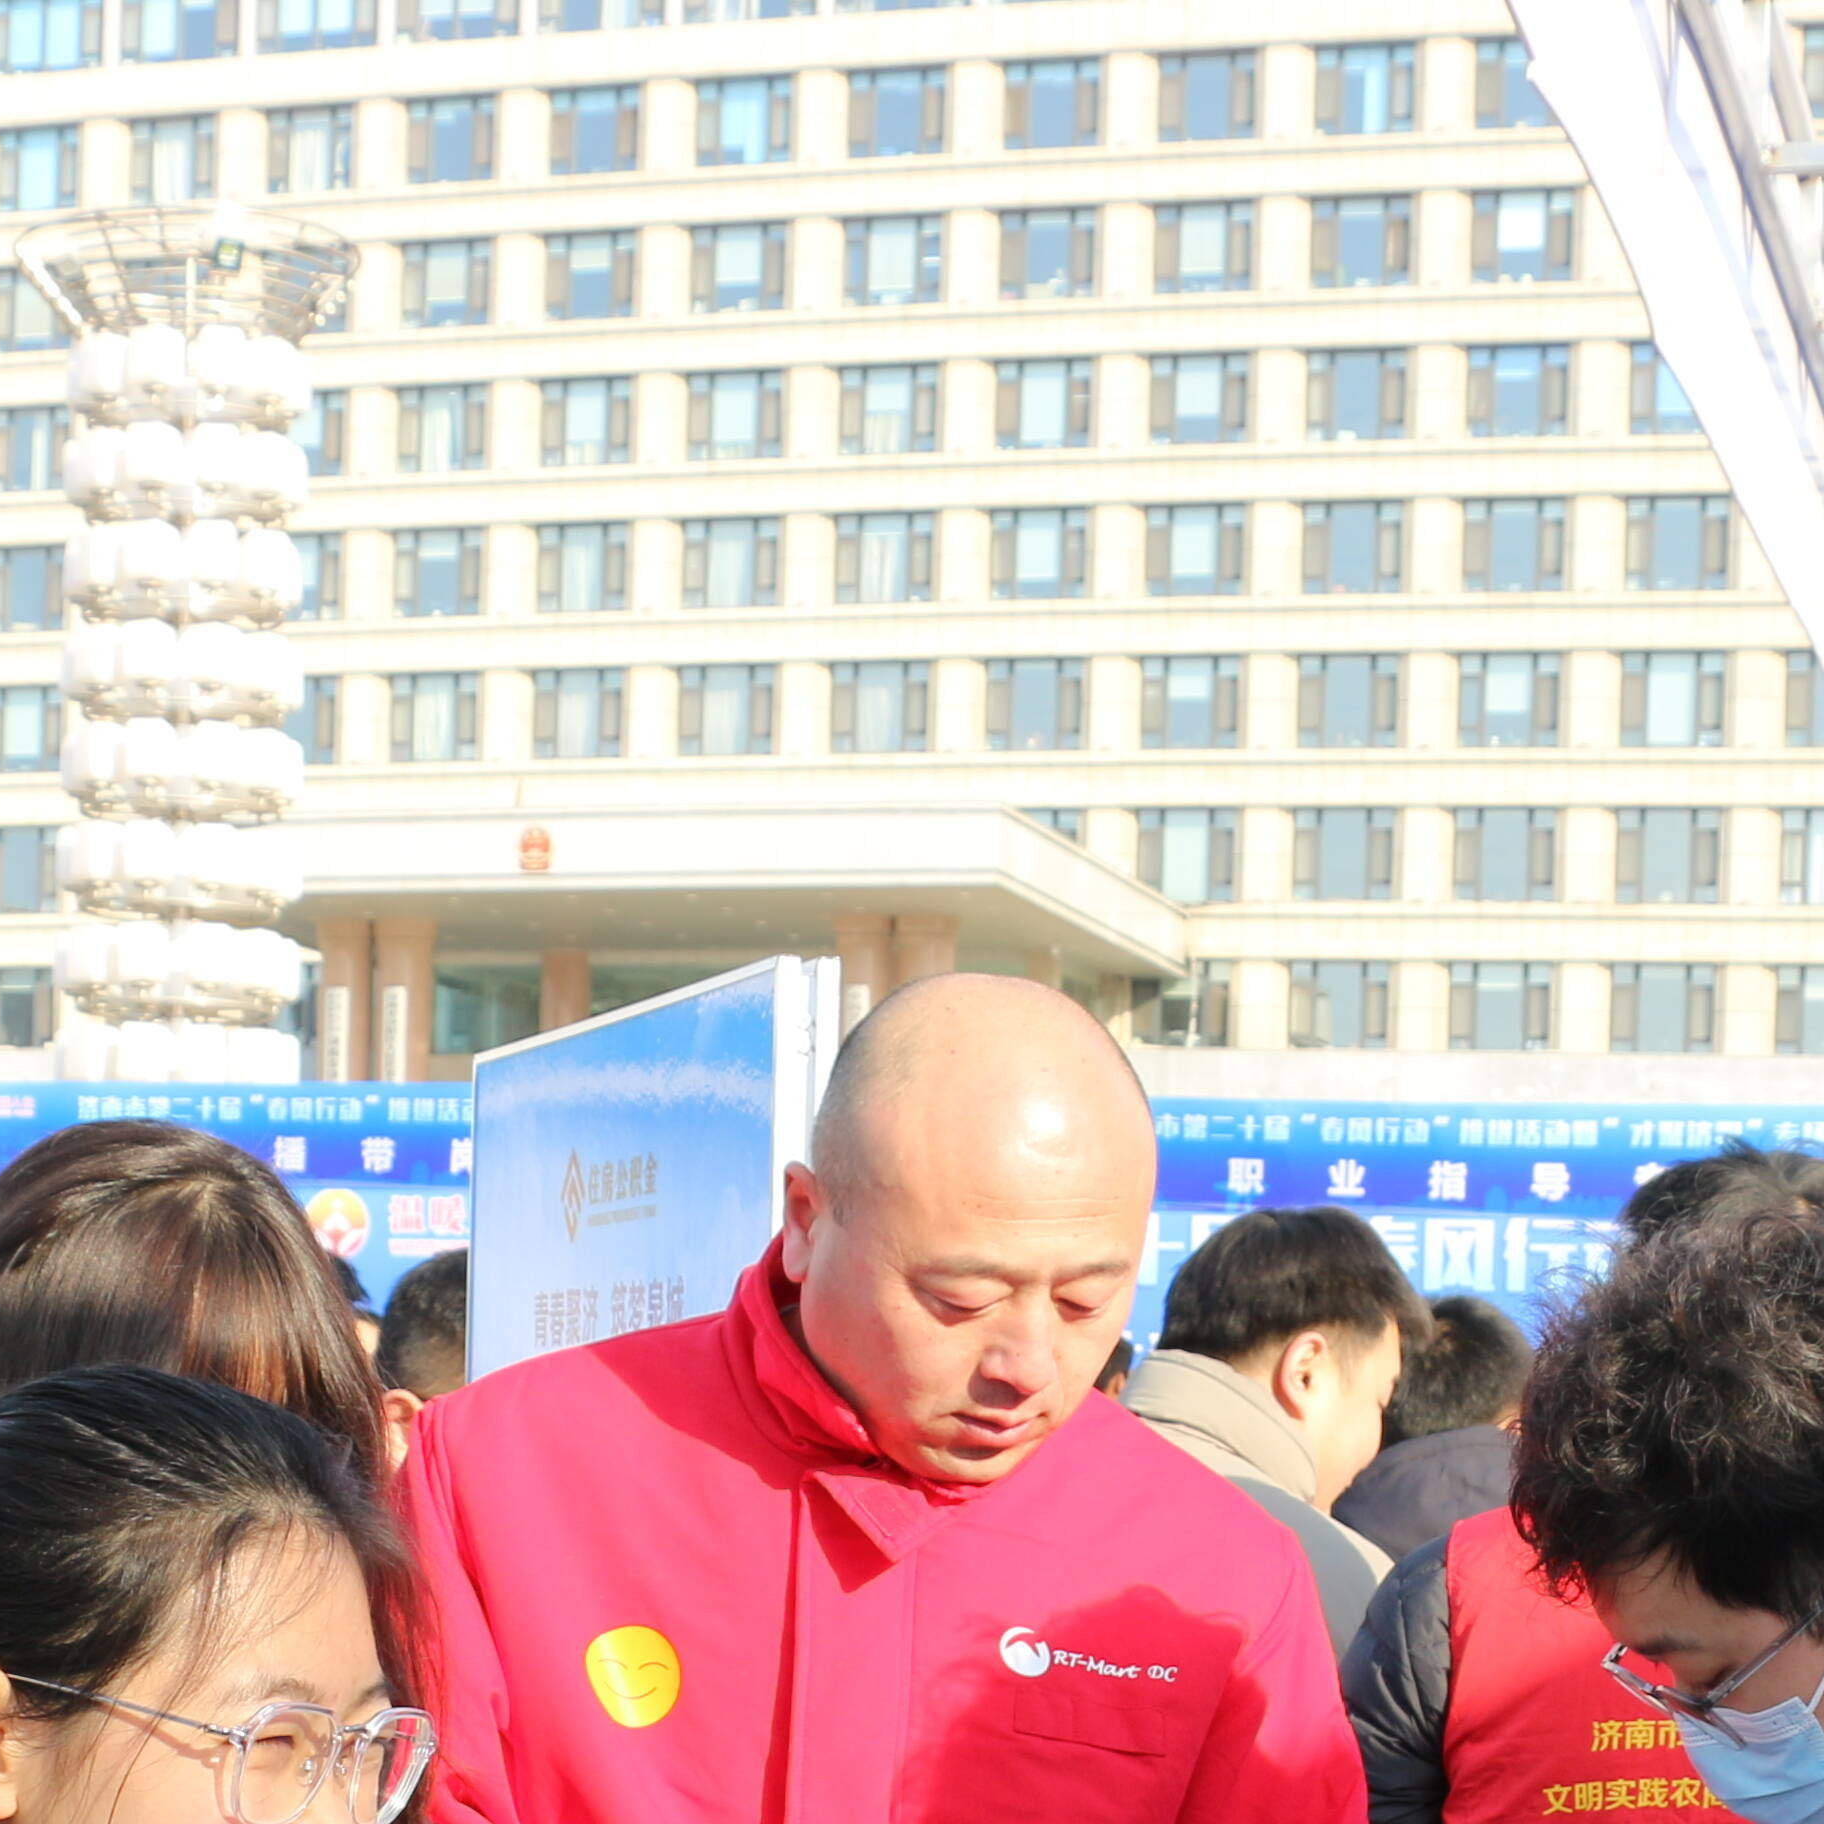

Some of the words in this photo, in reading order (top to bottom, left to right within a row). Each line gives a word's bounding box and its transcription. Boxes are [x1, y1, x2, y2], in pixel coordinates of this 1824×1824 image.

[587, 1152, 658, 1205] 住房公积金
[1052, 1649, 1142, 1679] RT-Mart
[1147, 1665, 1178, 1682] DC
